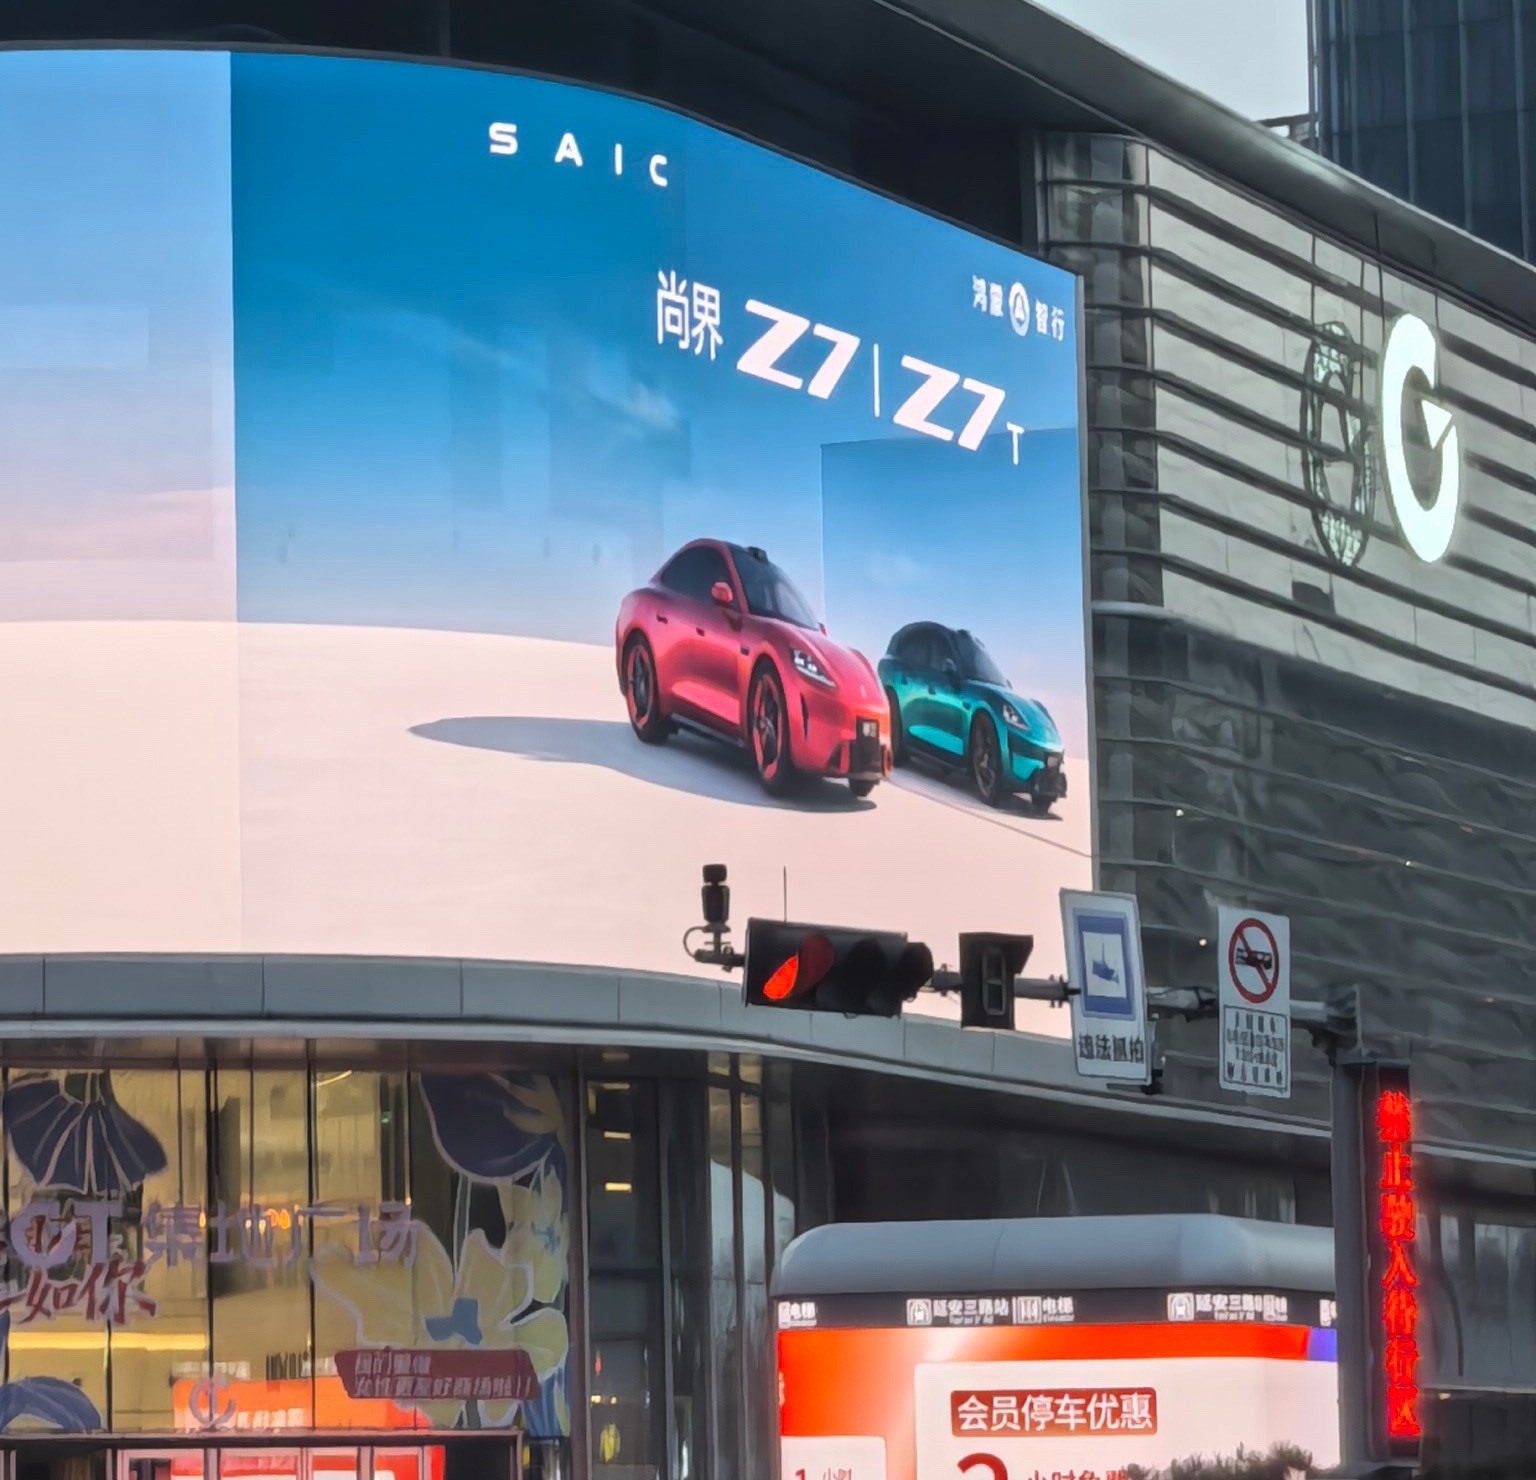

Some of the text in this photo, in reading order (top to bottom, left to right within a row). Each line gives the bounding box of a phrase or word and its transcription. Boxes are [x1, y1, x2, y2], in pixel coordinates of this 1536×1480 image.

[488, 122, 669, 187] SAIC
[656, 270, 724, 361] 尚界
[736, 299, 860, 399] Z7
[957, 1392, 1154, 1432] 会员停车优惠
